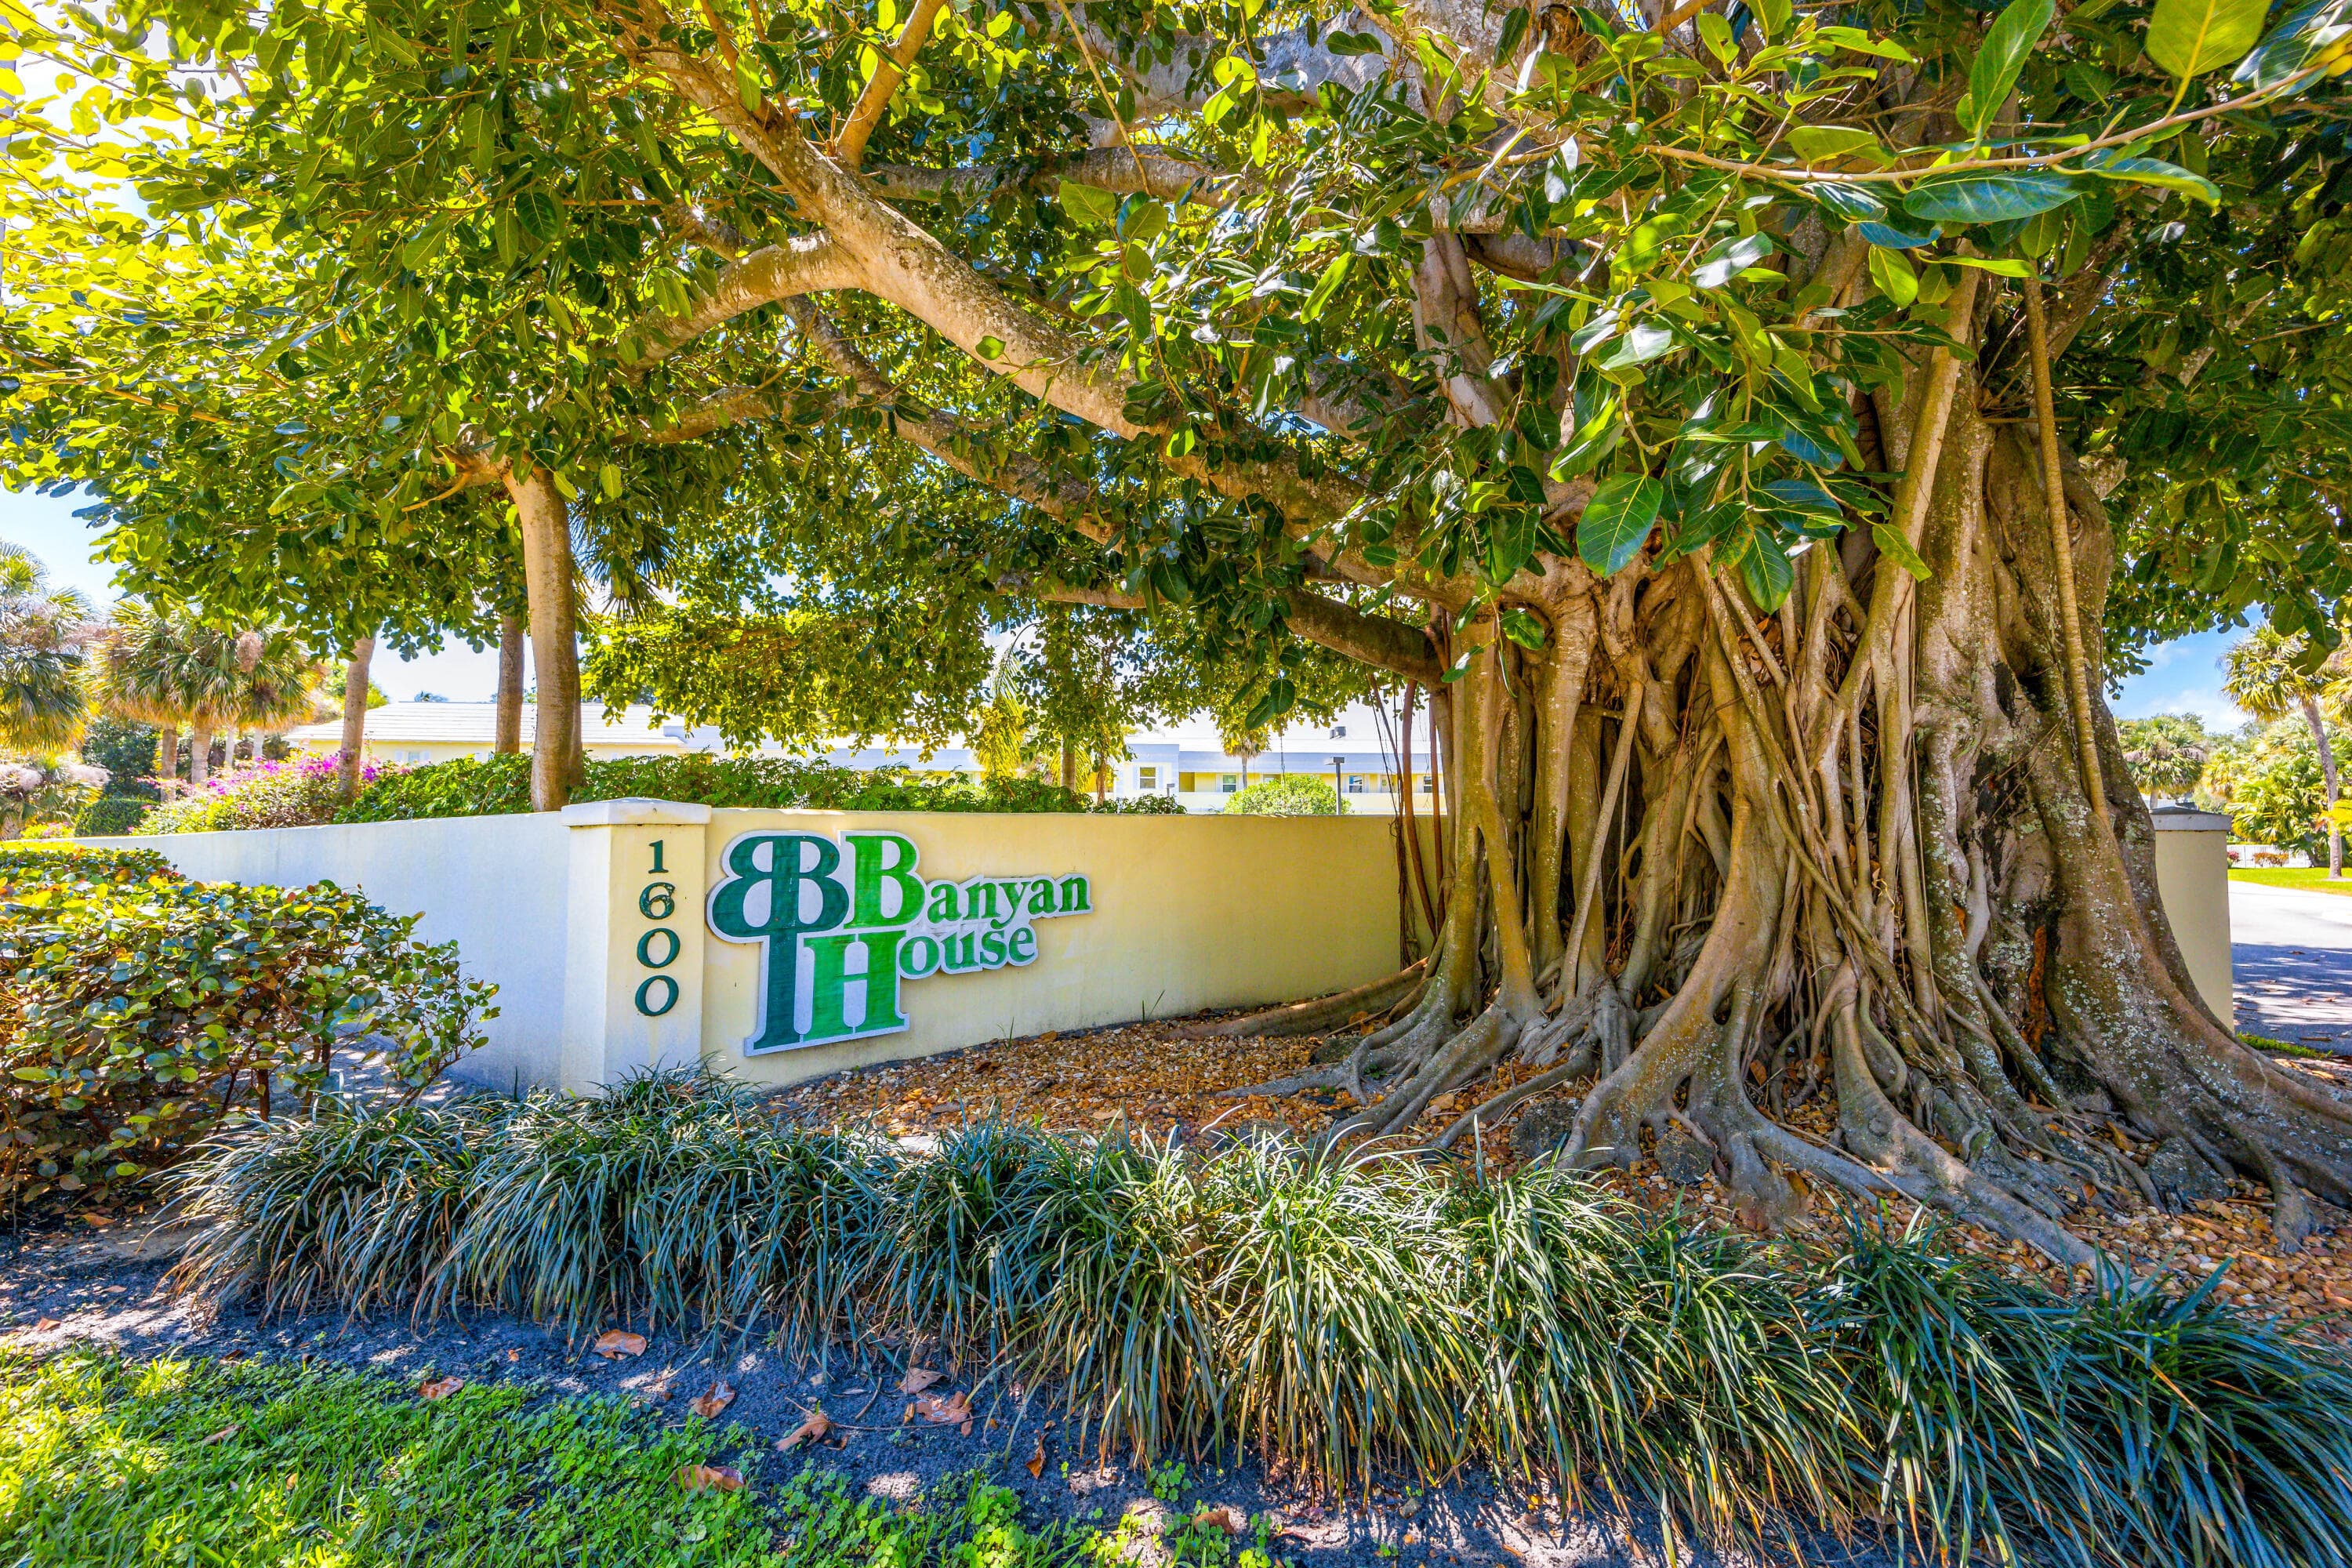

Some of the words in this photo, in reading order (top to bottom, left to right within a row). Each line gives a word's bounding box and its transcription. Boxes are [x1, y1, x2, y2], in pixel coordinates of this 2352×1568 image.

[635, 840, 681, 1017] 1600
[844, 835, 1091, 928] Banyan
[802, 926, 1036, 1042] House
